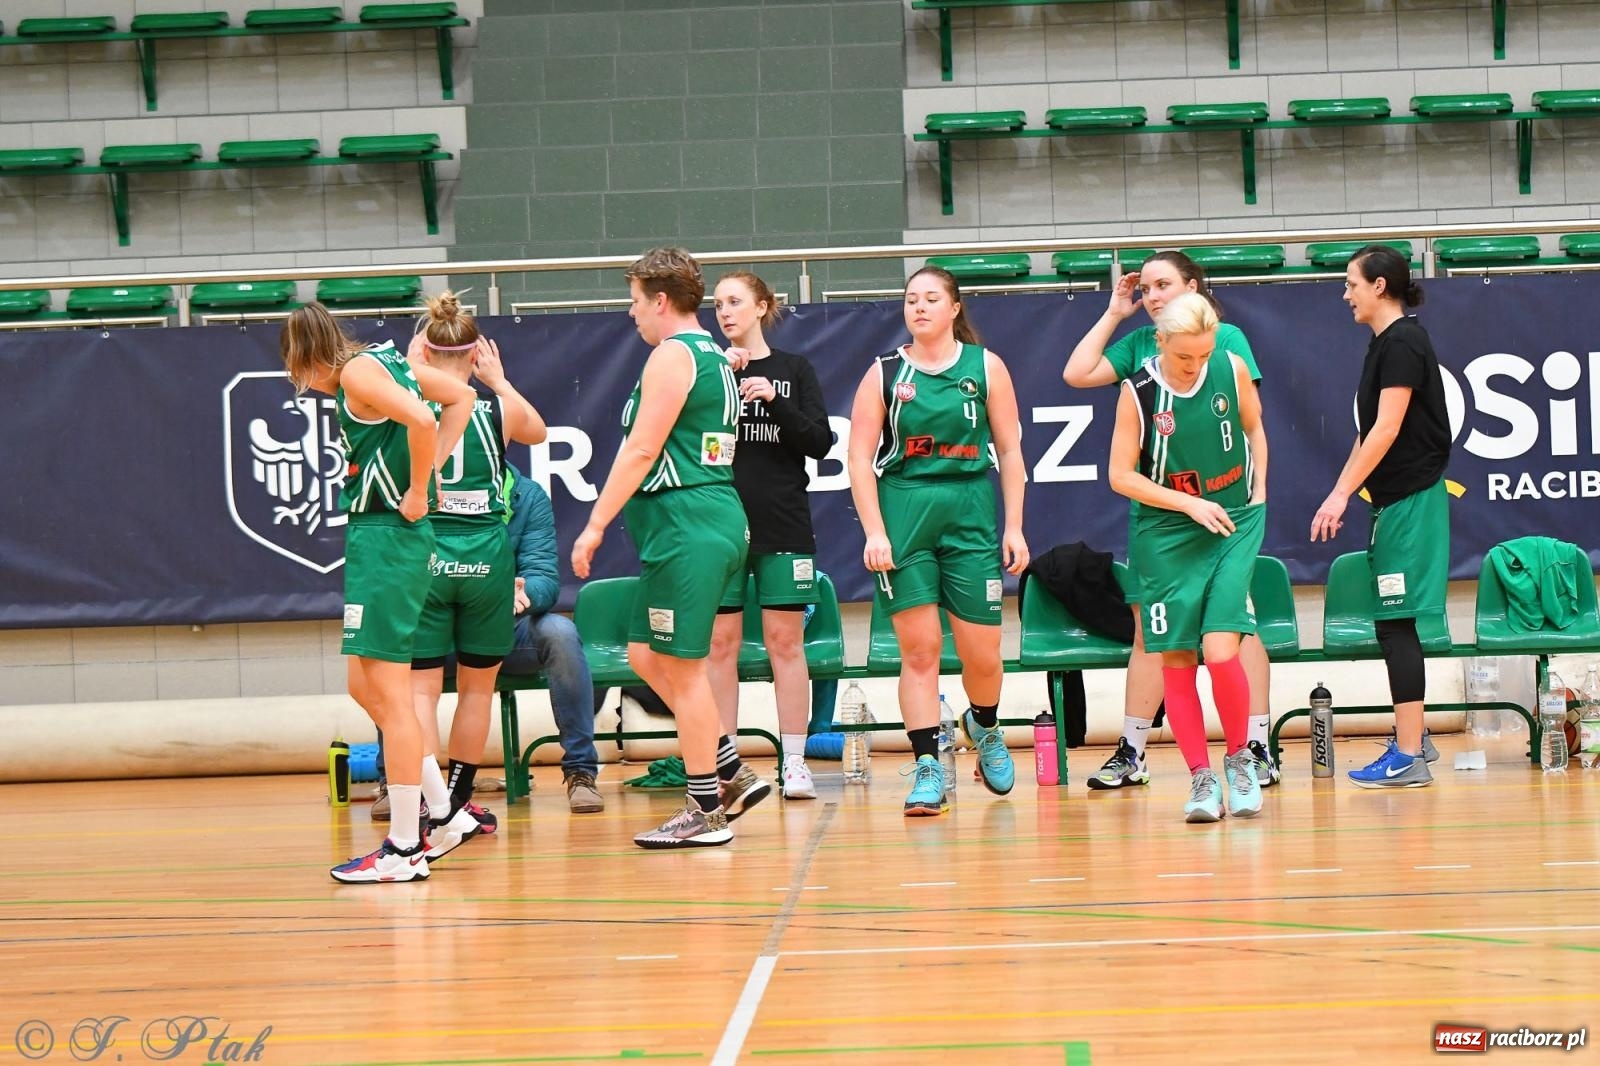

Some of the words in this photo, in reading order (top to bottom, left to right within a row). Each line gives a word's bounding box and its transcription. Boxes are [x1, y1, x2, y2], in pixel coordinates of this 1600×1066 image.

[963, 400, 978, 428] 4
[743, 423, 781, 443] THINK
[1220, 420, 1233, 452] 8
[1488, 470, 1600, 501] RACIB
[444, 561, 491, 575] Clavis
[877, 570, 894, 600] 4
[1150, 602, 1168, 635] 8
[1312, 715, 1328, 768] isostar
